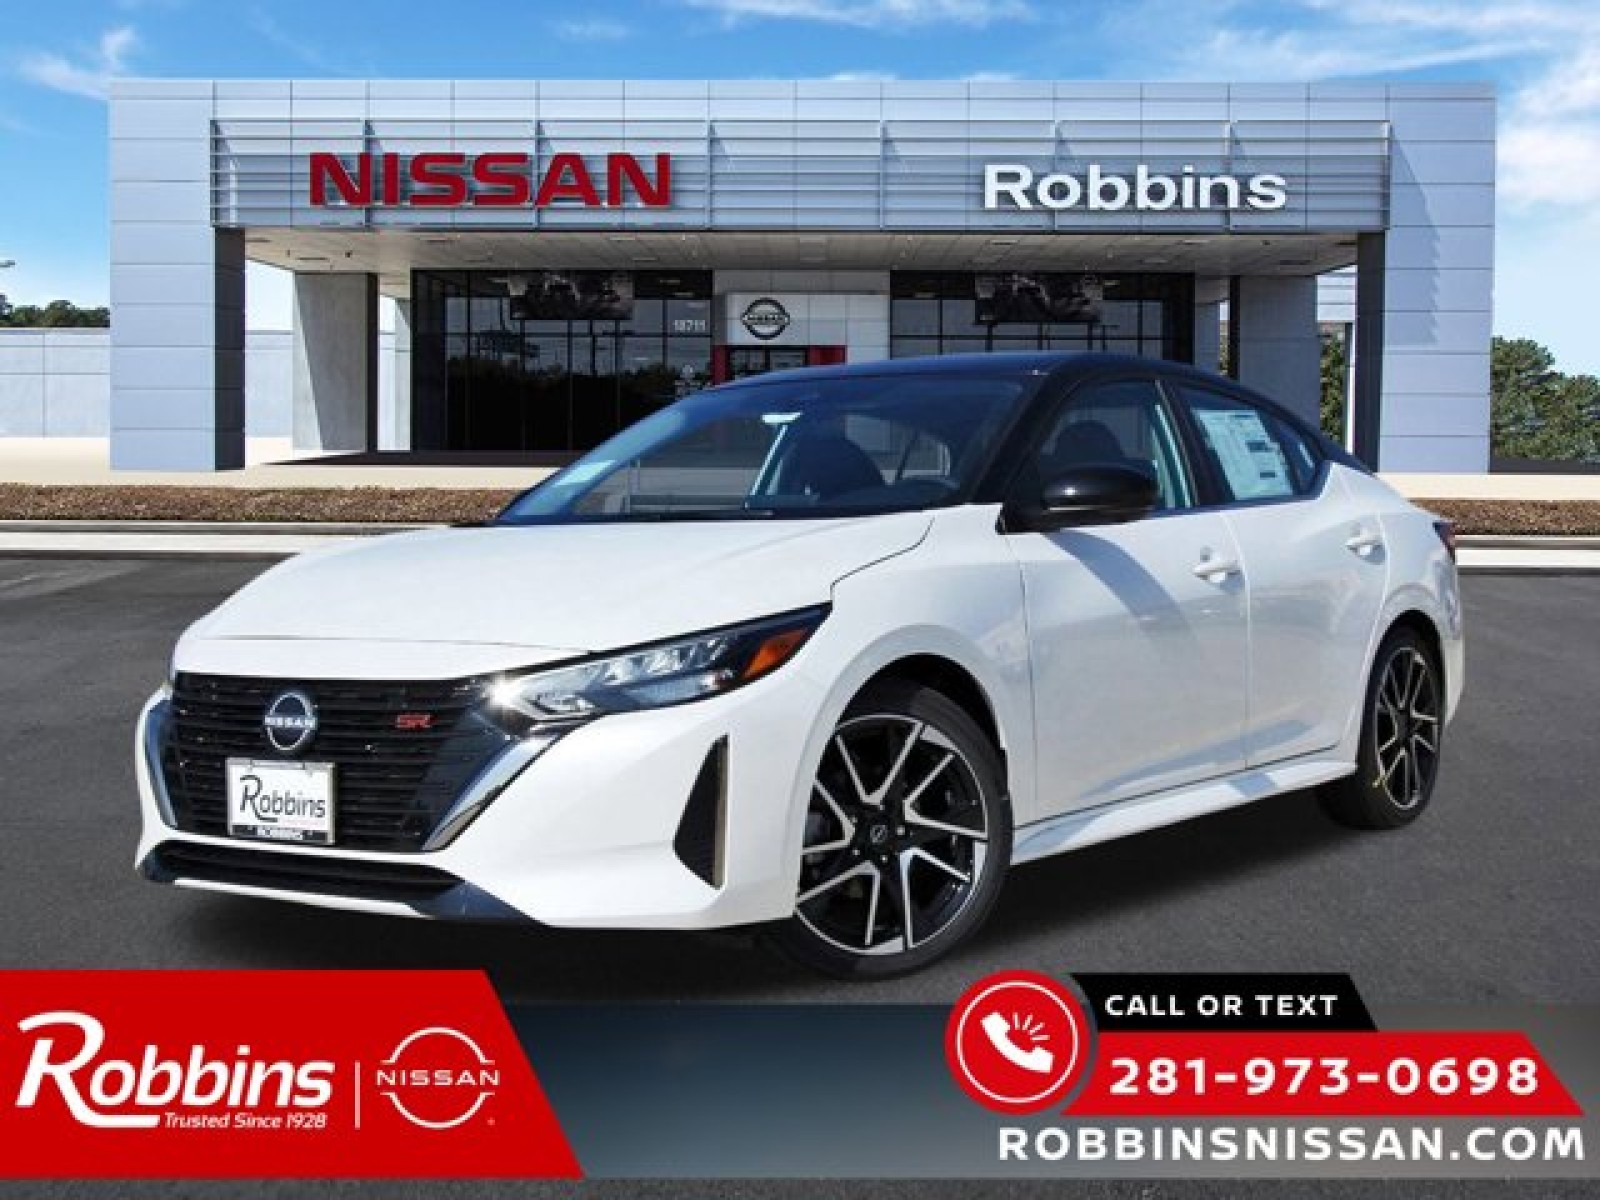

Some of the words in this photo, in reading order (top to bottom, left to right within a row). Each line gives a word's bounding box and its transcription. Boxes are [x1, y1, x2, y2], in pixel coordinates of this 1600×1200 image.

[309, 153, 670, 207] NISSAN
[984, 164, 1287, 211] Robbins
[264, 714, 318, 730] NISSAN
[395, 713, 434, 730] SR
[239, 774, 327, 823] Robbins
